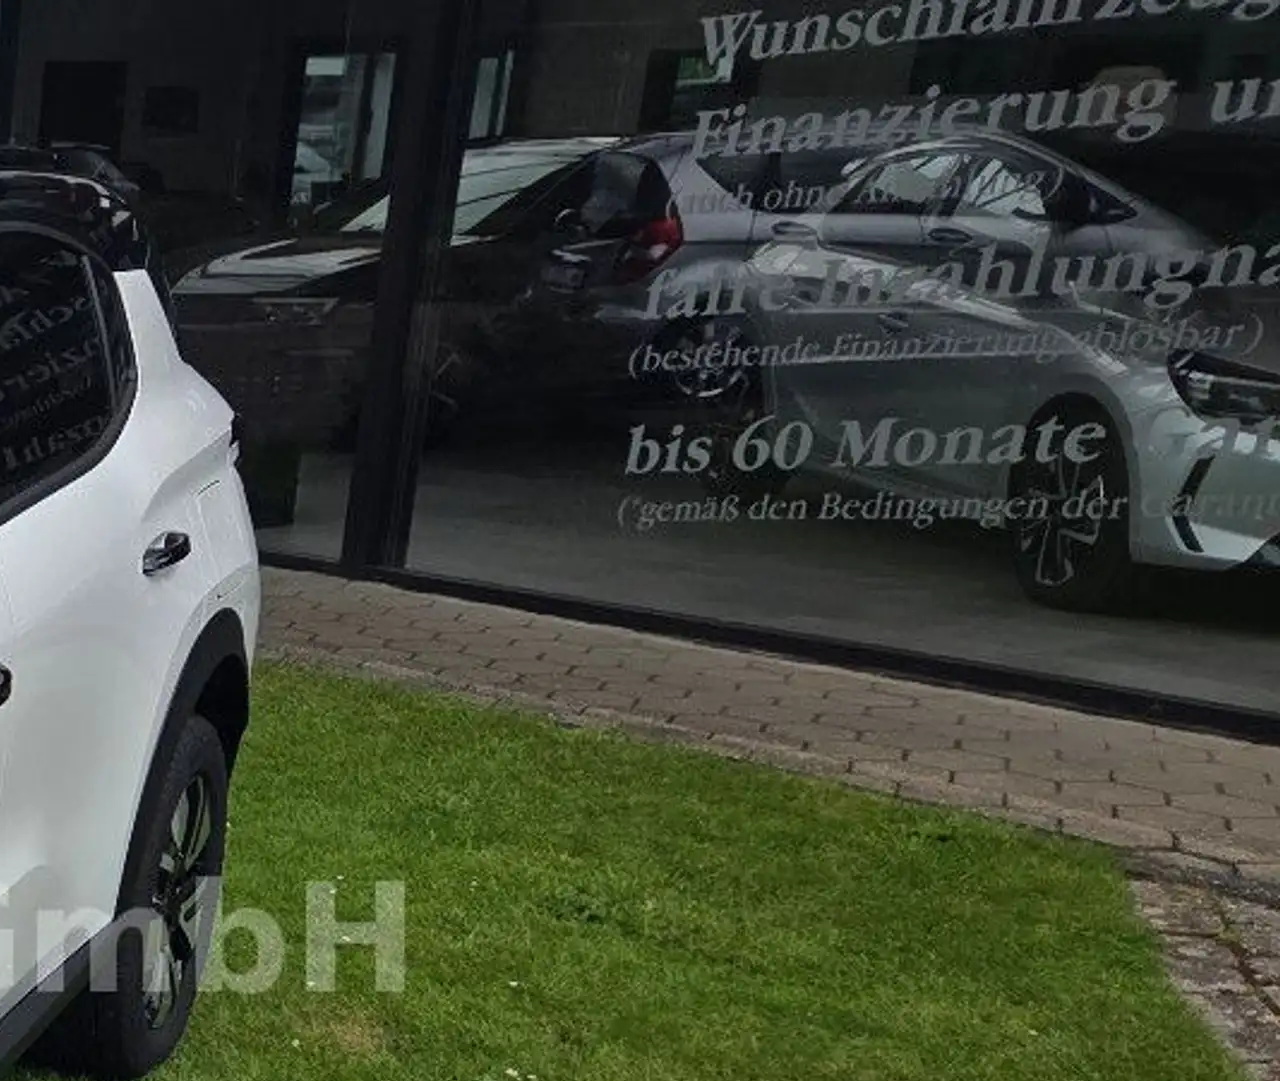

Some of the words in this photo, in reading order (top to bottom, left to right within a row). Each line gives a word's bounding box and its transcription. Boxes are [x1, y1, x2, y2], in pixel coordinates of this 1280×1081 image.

[700, 0, 1280, 64] Wunschfa
[690, 78, 1178, 159] Finanzierung
[624, 423, 713, 476] bis
[732, 414, 814, 472] 60
[829, 414, 1108, 469] Monate
[747, 493, 808, 521] den
[817, 490, 1049, 530] Bedingungen
[1061, 487, 1129, 521] der
